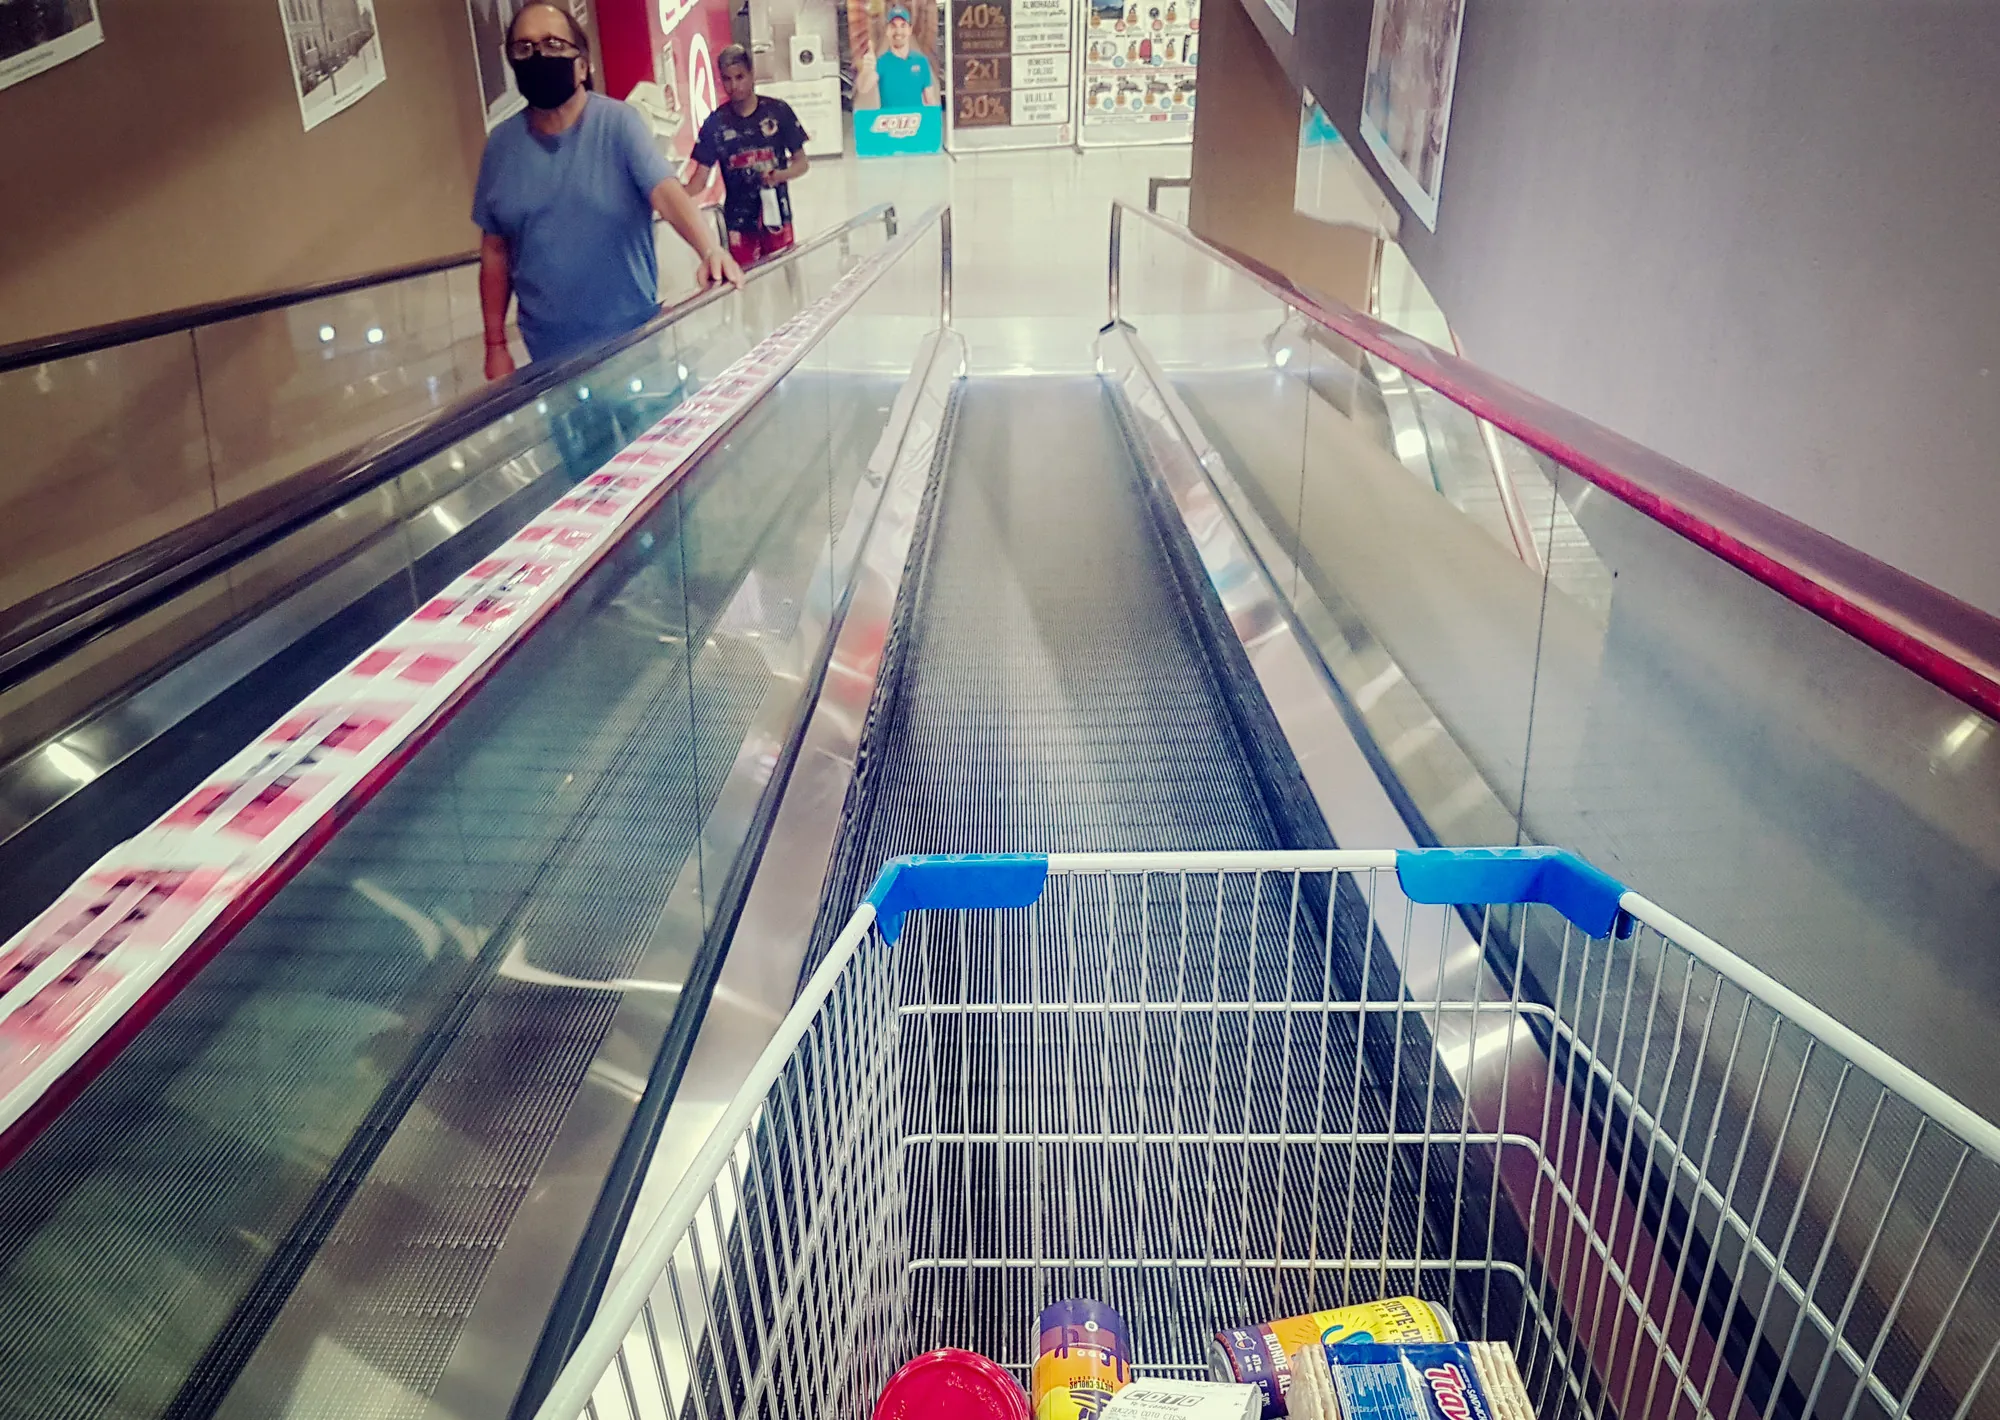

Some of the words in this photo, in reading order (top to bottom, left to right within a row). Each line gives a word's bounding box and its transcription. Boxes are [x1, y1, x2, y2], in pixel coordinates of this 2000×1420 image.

[958, 4, 1006, 28] 40%
[965, 58, 1000, 81] 2x1
[960, 94, 1006, 119] 30%
[1263, 1333, 1289, 1372] BLONDE
[1277, 1374, 1291, 1395] ALE
[1123, 1390, 1205, 1407] COTO
